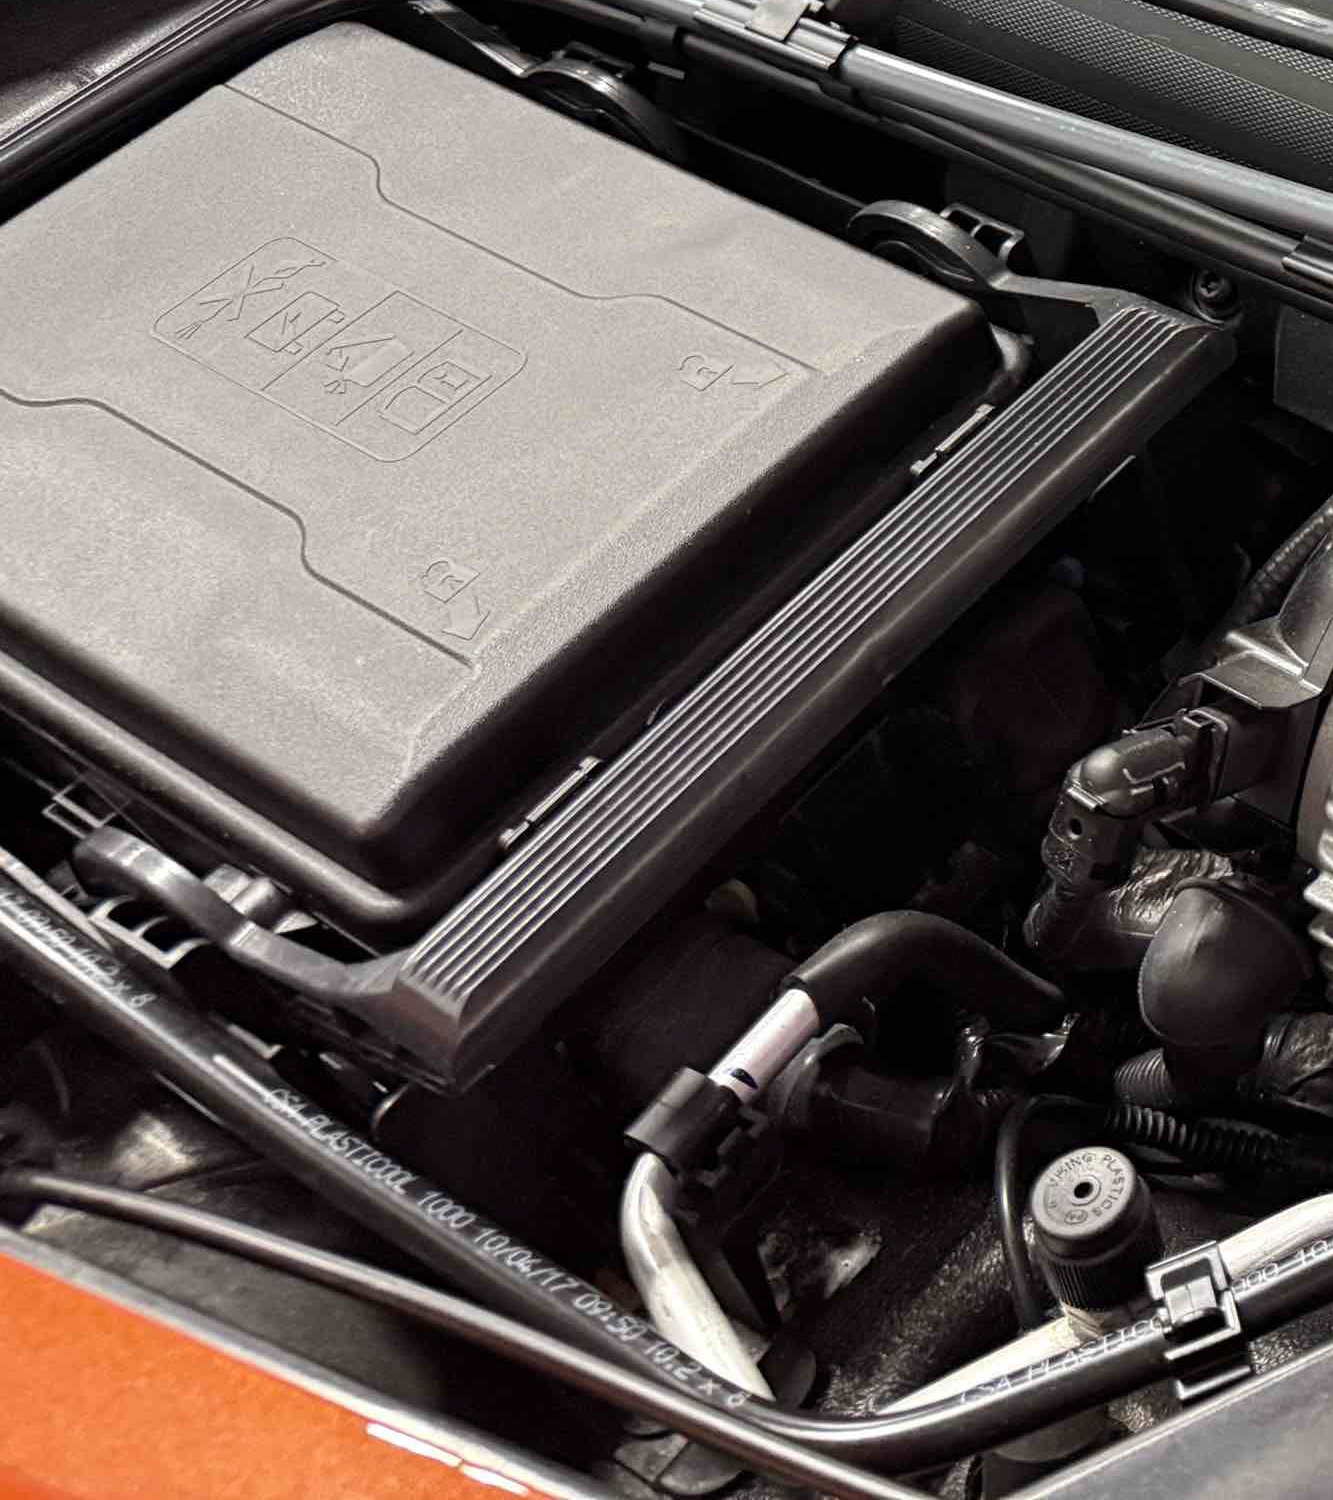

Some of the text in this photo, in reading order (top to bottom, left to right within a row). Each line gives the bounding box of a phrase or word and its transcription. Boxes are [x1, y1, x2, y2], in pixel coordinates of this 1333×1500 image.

[417, 1190, 478, 1228] 1000
[474, 1227, 579, 1292] 10/04/17
[574, 1293, 648, 1341] 09:50
[645, 1341, 701, 1381] 10.2
[1231, 1263, 1280, 1293] 000
